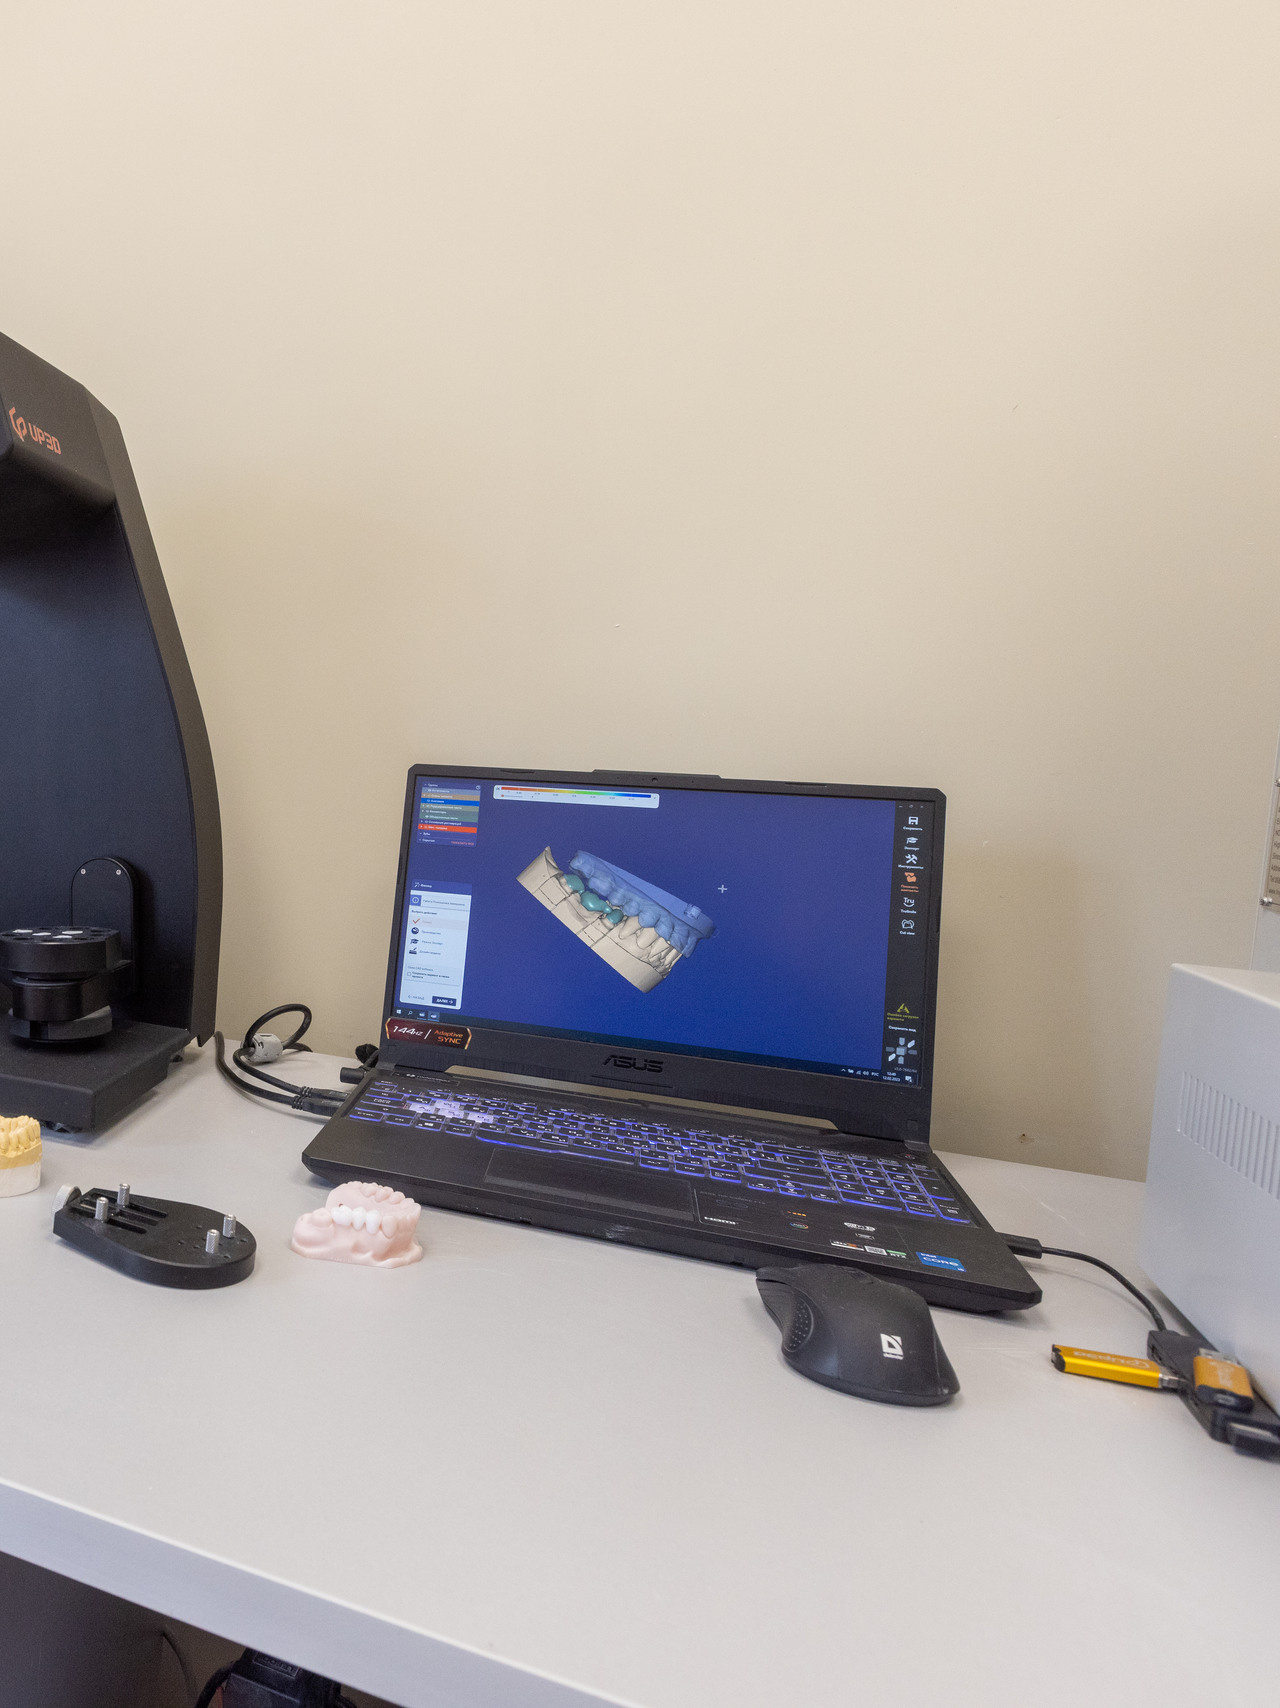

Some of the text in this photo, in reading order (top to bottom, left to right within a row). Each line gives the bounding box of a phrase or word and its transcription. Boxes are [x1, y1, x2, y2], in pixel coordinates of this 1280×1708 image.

[28, 422, 62, 455] UP3D
[433, 1029, 464, 1039] Adaptive
[437, 1036, 462, 1045] SYNC
[603, 1054, 664, 1074] ASUS
